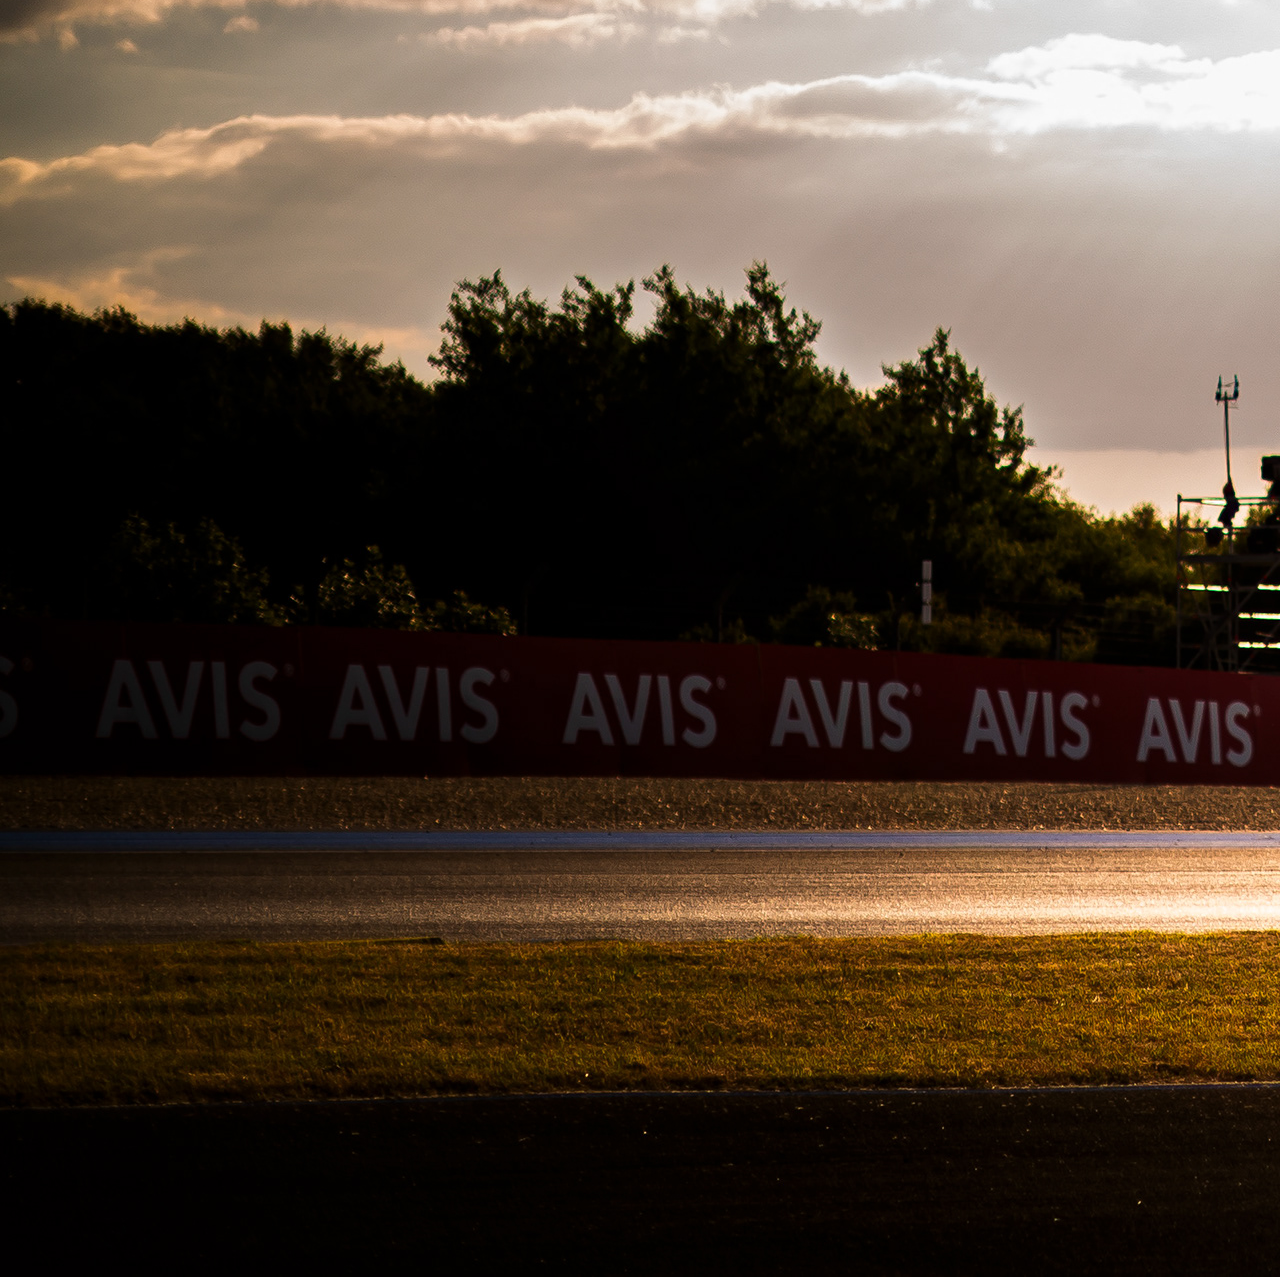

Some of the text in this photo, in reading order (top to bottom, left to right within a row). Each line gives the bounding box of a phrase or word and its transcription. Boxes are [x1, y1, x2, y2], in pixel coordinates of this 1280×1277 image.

[99, 659, 281, 741] AVIS
[333, 664, 499, 743] AVIS
[565, 672, 717, 748] AVIS
[772, 677, 912, 752] AVIS
[965, 688, 1090, 760] AVIS
[1138, 697, 1253, 767] AVIS
